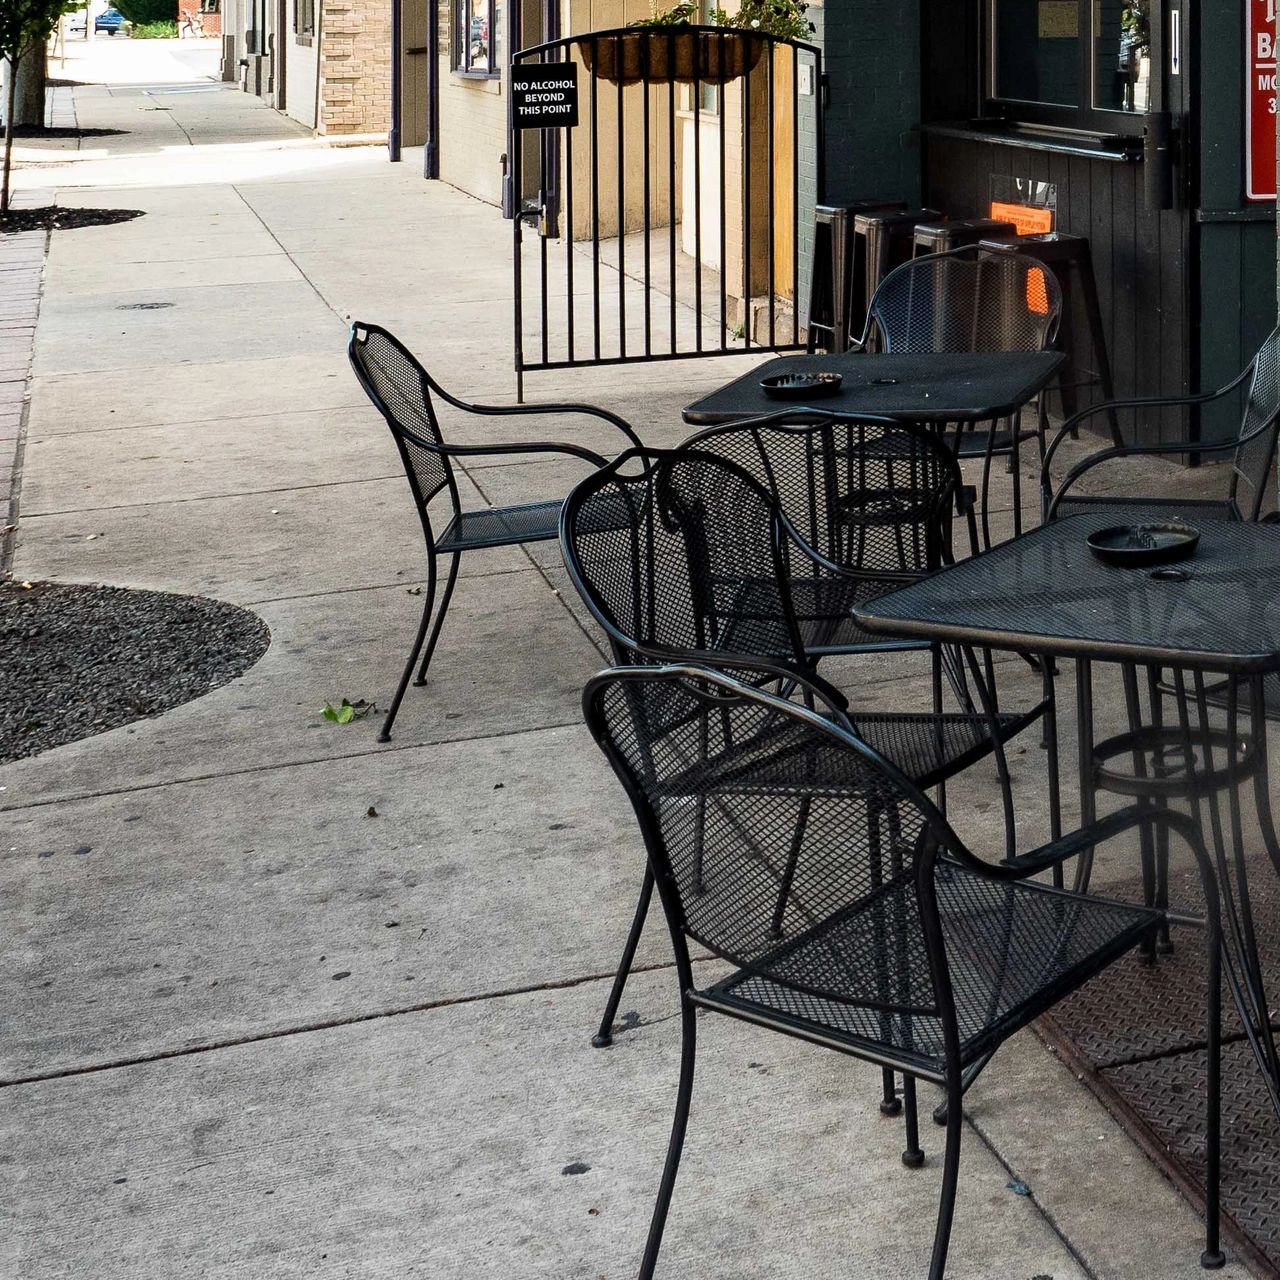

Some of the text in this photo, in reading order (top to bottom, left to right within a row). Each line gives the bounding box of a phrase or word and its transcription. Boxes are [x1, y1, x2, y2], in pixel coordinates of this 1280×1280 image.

[513, 80, 576, 91] NO ALCOHOL
[525, 92, 565, 103] BEYOND
[518, 104, 572, 115] THIS POINT
